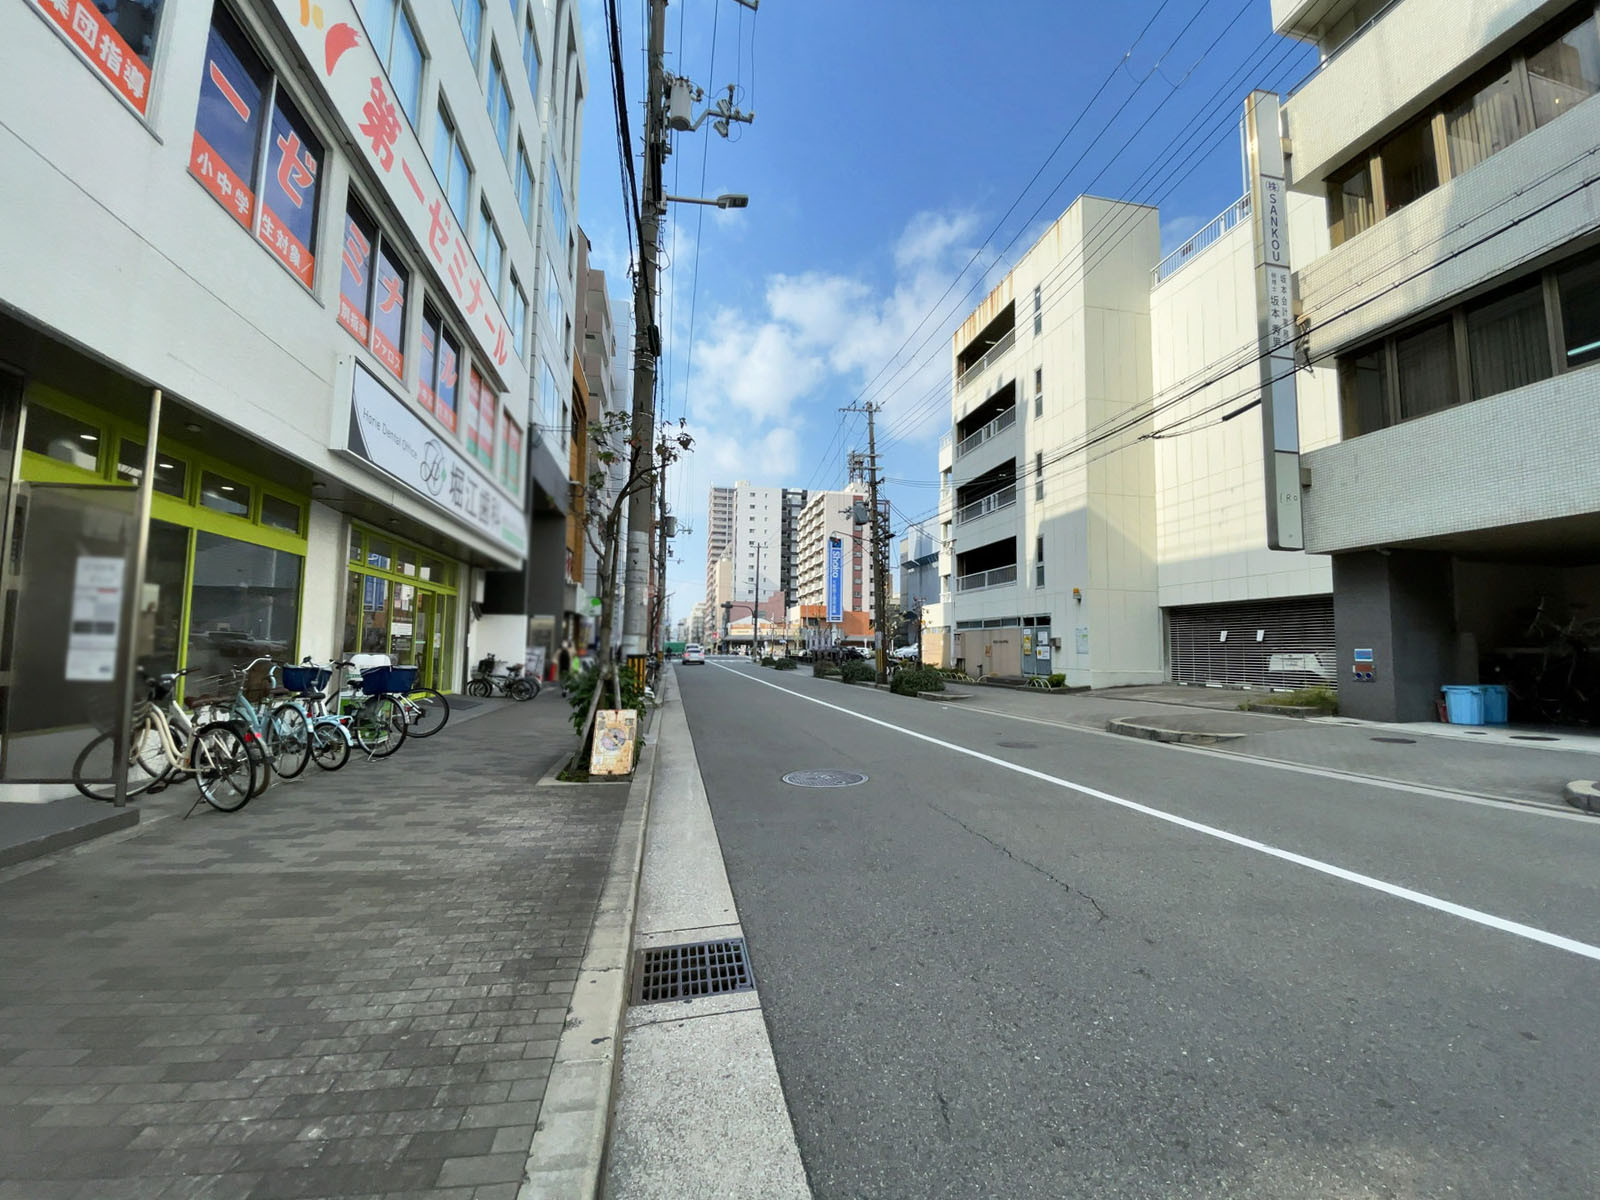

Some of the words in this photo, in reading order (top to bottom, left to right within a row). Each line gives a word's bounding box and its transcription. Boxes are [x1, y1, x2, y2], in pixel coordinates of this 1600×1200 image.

[359, 76, 507, 366] 第一ゼミナール
[382, 422, 400, 446] Dental
